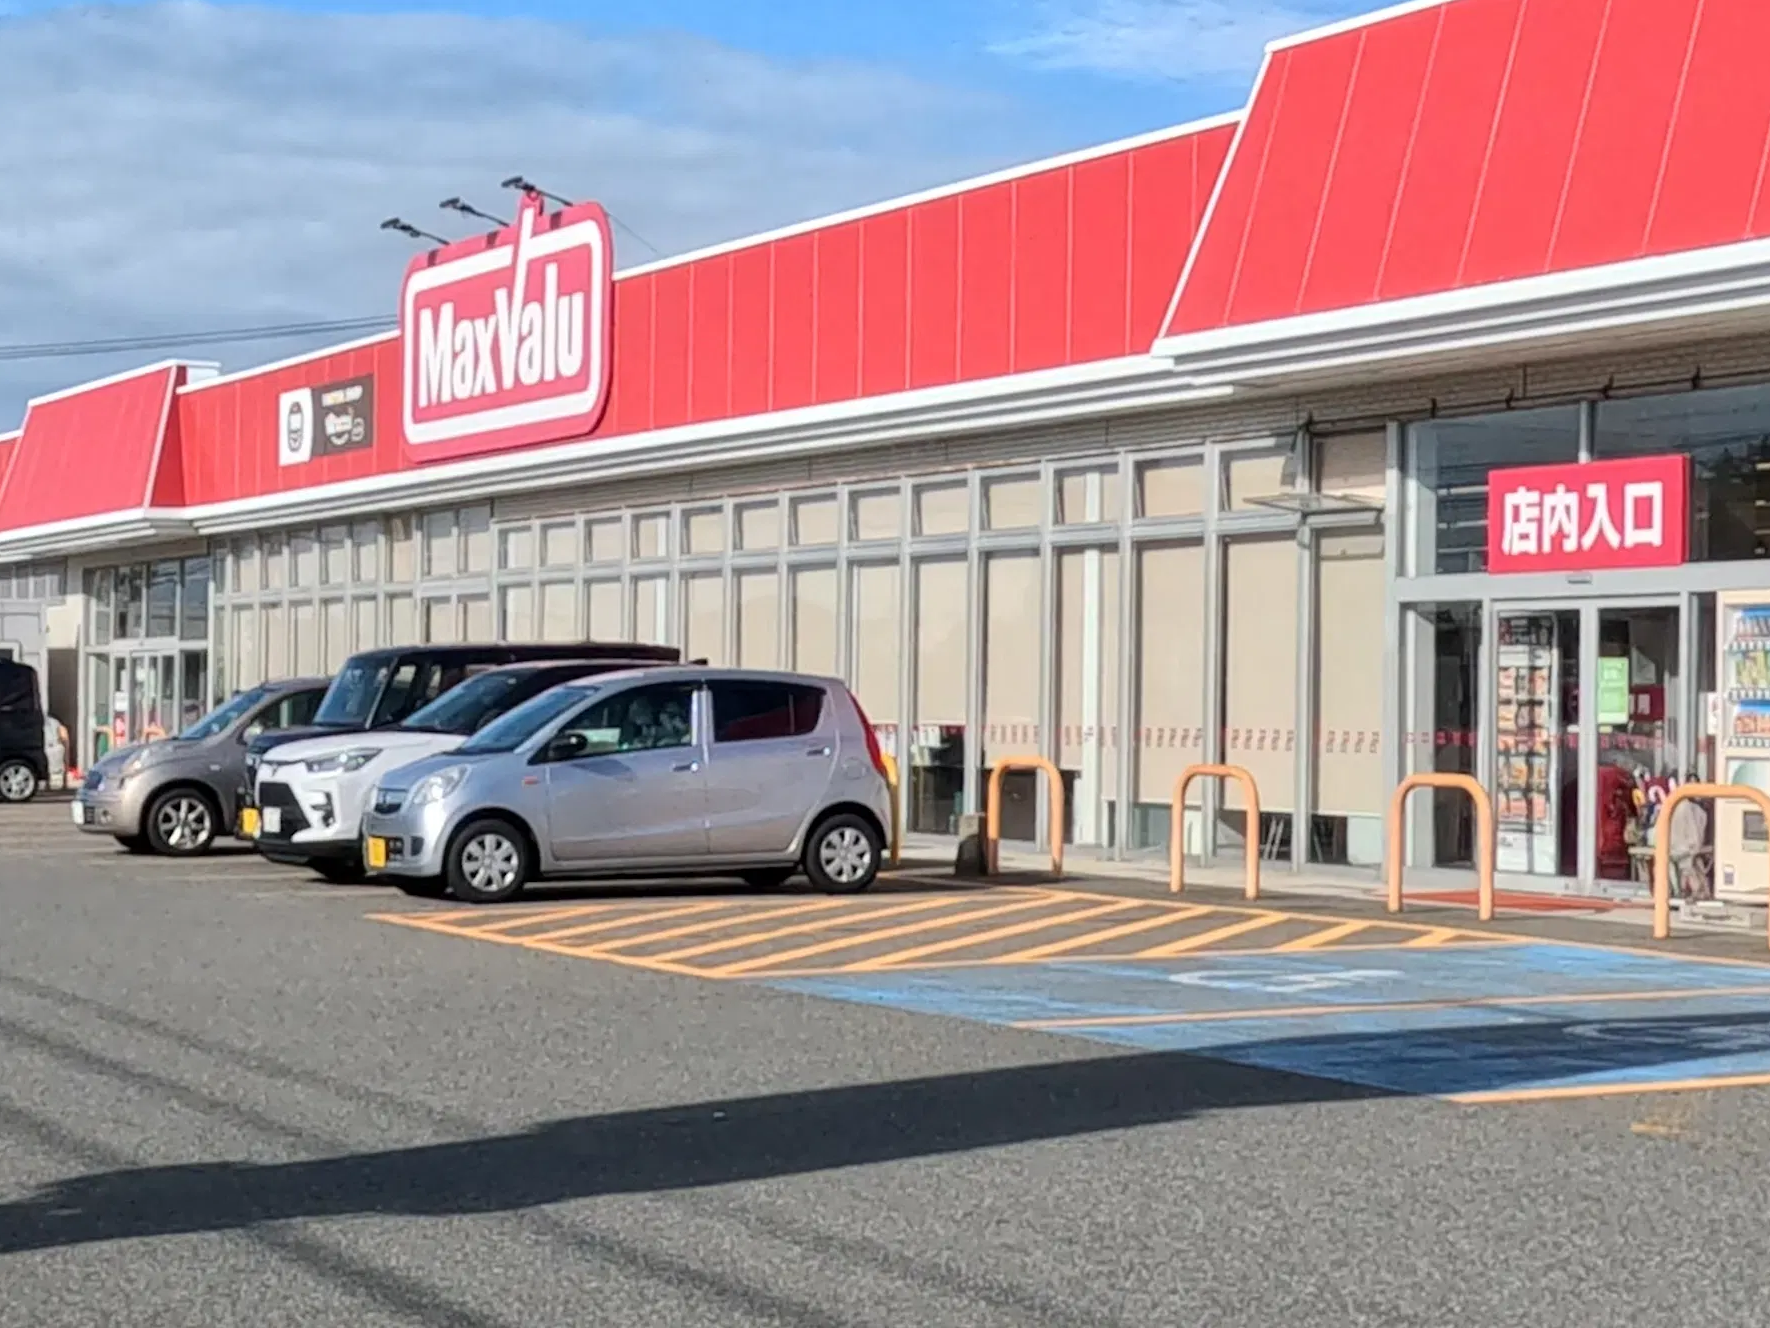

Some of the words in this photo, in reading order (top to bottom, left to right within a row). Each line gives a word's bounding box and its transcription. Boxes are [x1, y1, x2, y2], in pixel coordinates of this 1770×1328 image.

[418, 208, 585, 409] MaxValu
[1502, 480, 1664, 556] 店内入口
